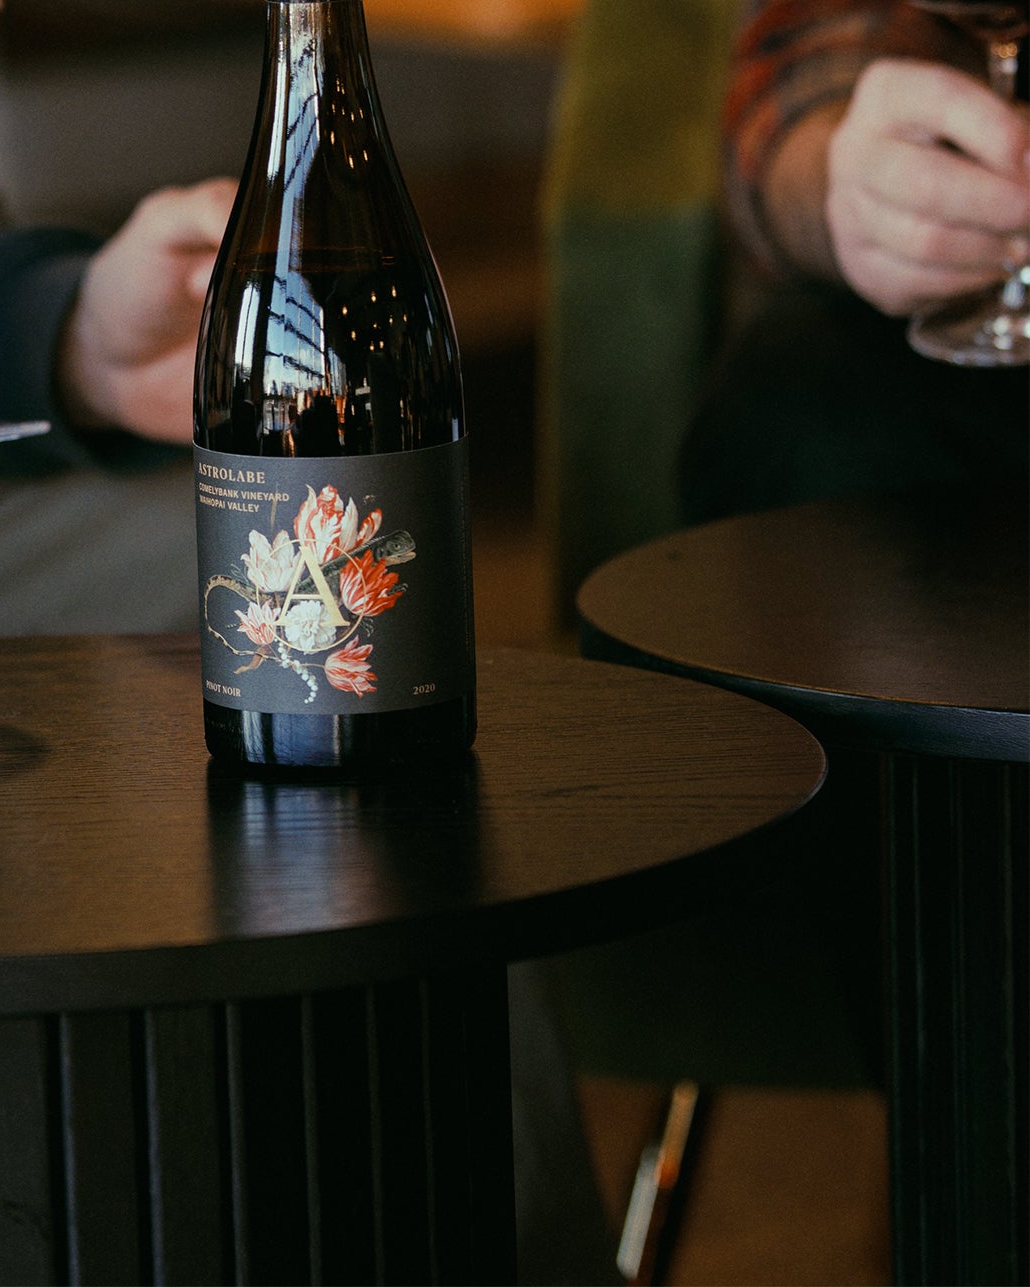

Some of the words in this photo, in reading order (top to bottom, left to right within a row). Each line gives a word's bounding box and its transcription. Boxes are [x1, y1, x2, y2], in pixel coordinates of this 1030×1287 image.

[198, 462, 266, 484] ASTROLABE
[241, 490, 290, 502] VINEYARD
[227, 500, 260, 513] VALLEY
[275, 546, 350, 627] A
[222, 685, 242, 697] NOIR
[412, 682, 436, 696] 2020
